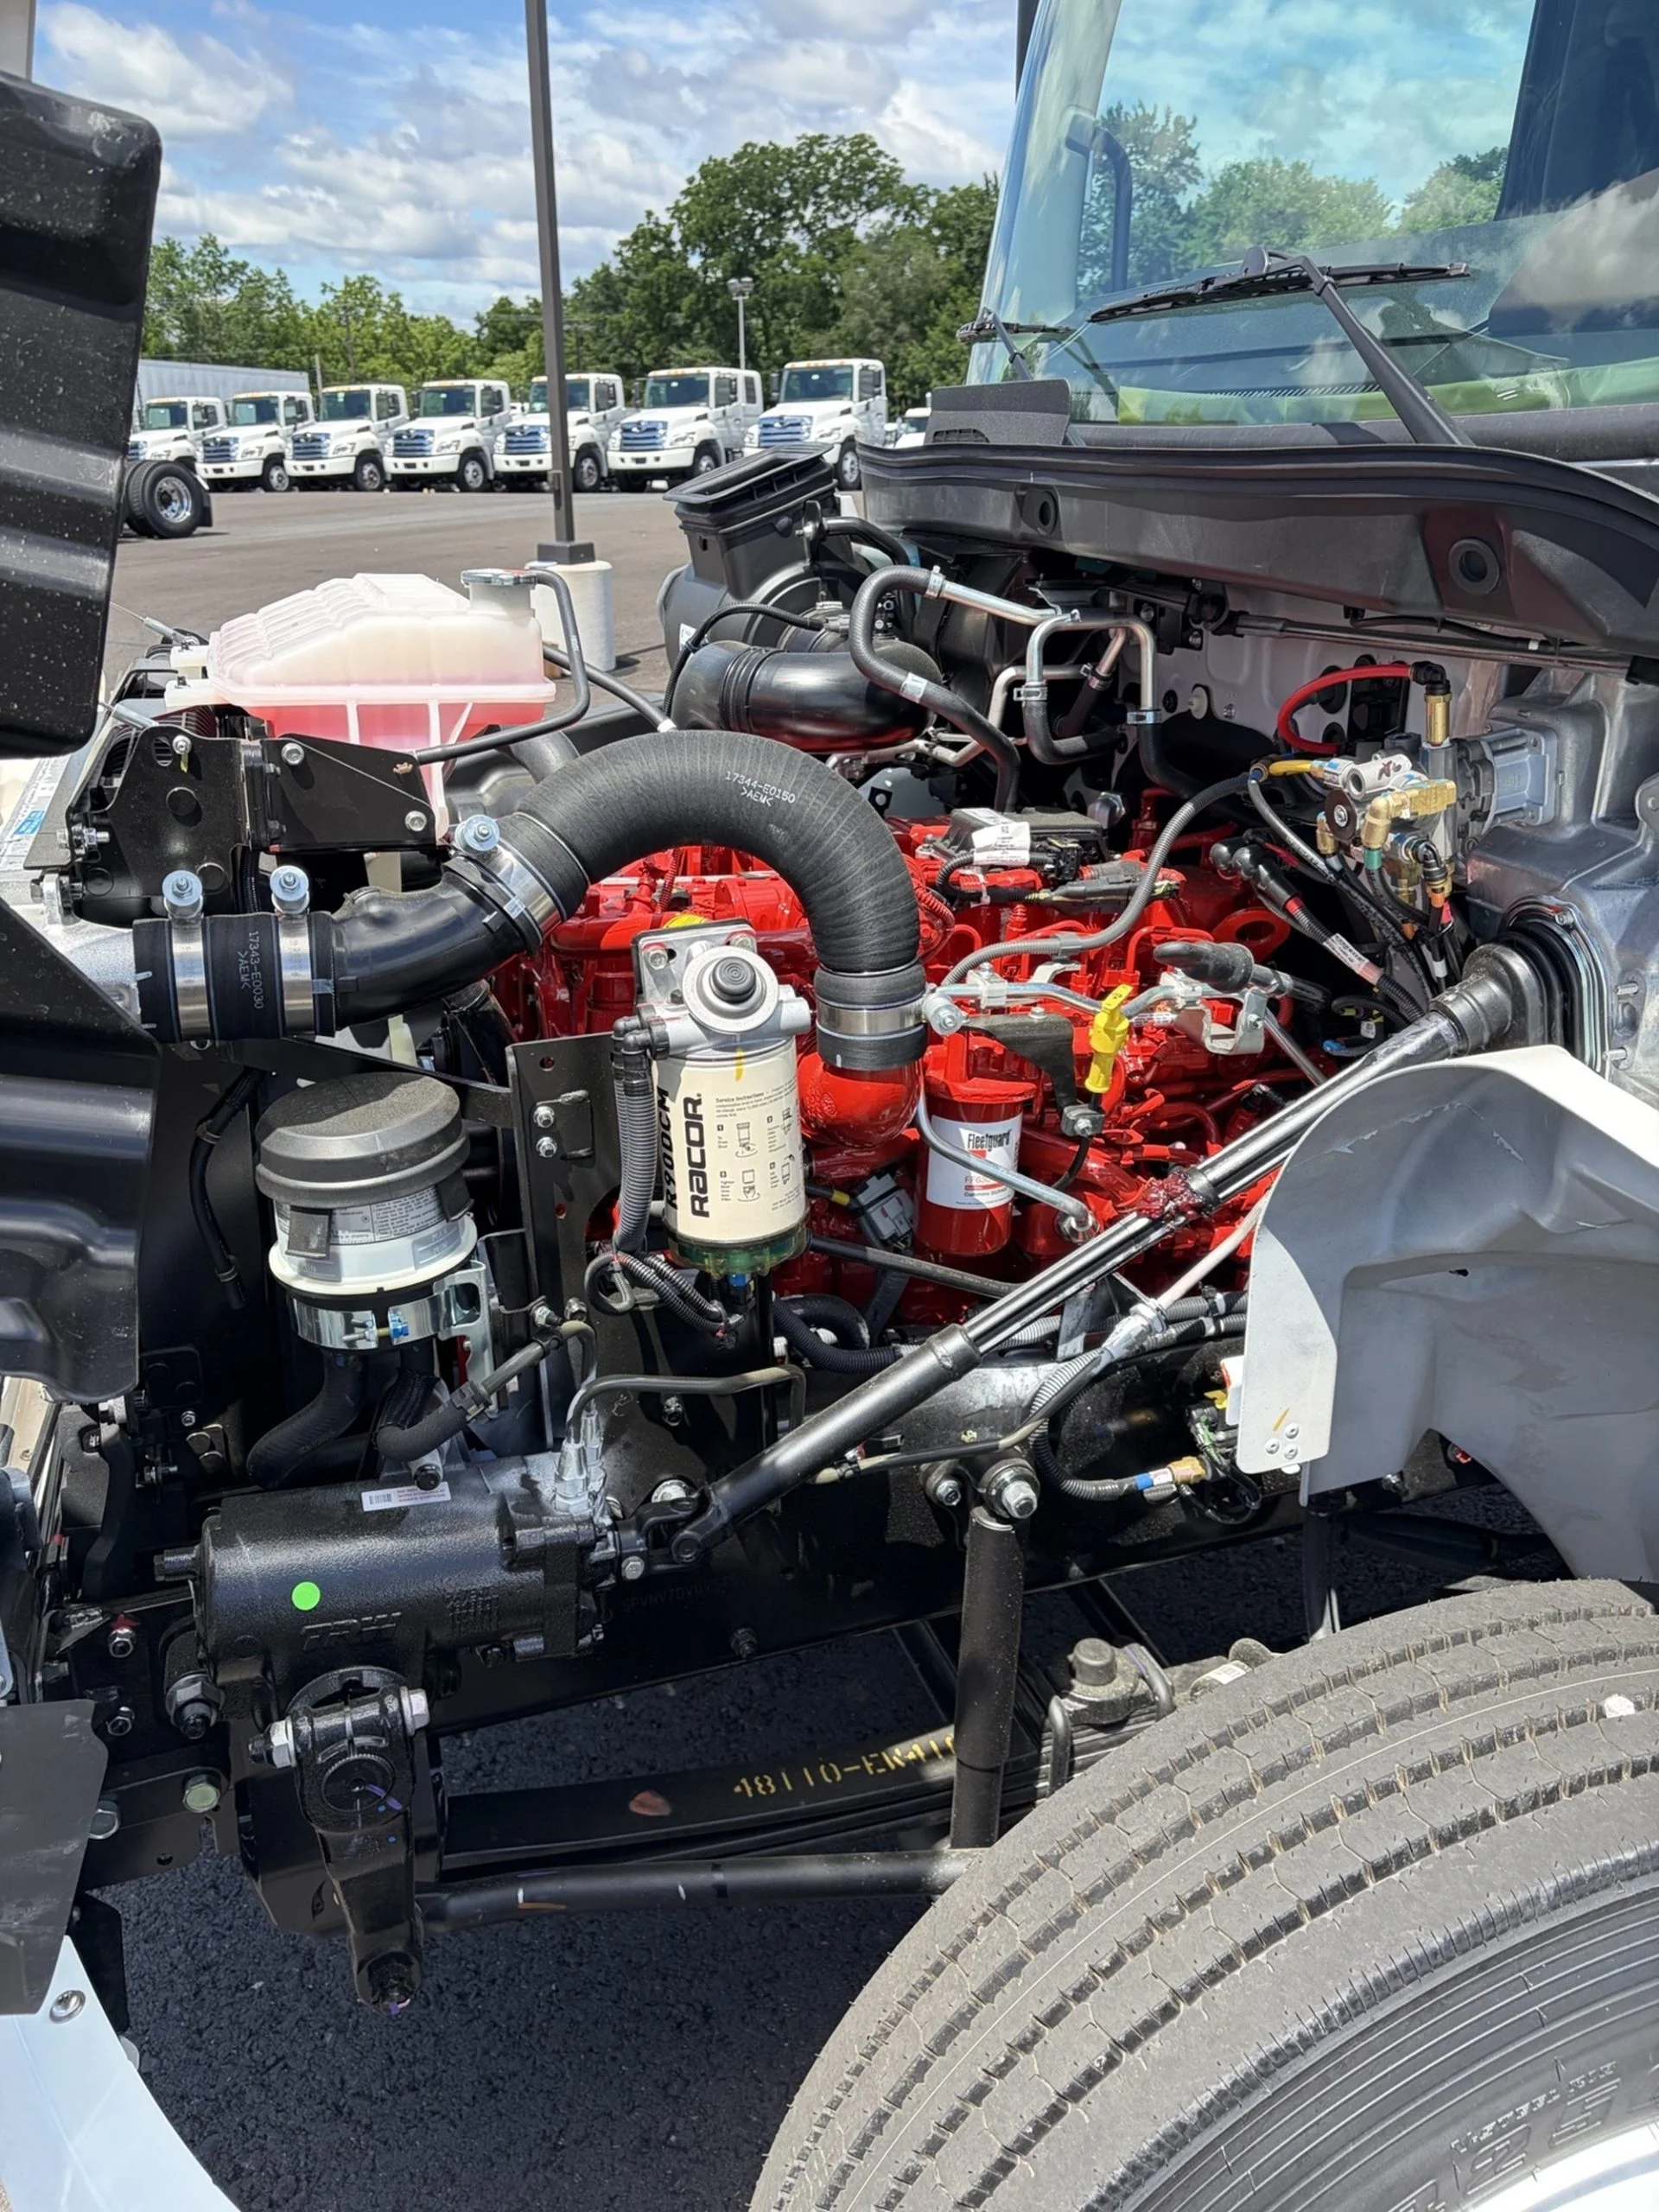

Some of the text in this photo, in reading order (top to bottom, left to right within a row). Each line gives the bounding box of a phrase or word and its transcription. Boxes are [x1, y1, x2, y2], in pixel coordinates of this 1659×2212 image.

[725, 770, 796, 804] 17344-E0150
[248, 931, 264, 1009] 17343-E0030
[968, 1128, 1012, 1153] Fleetguard
